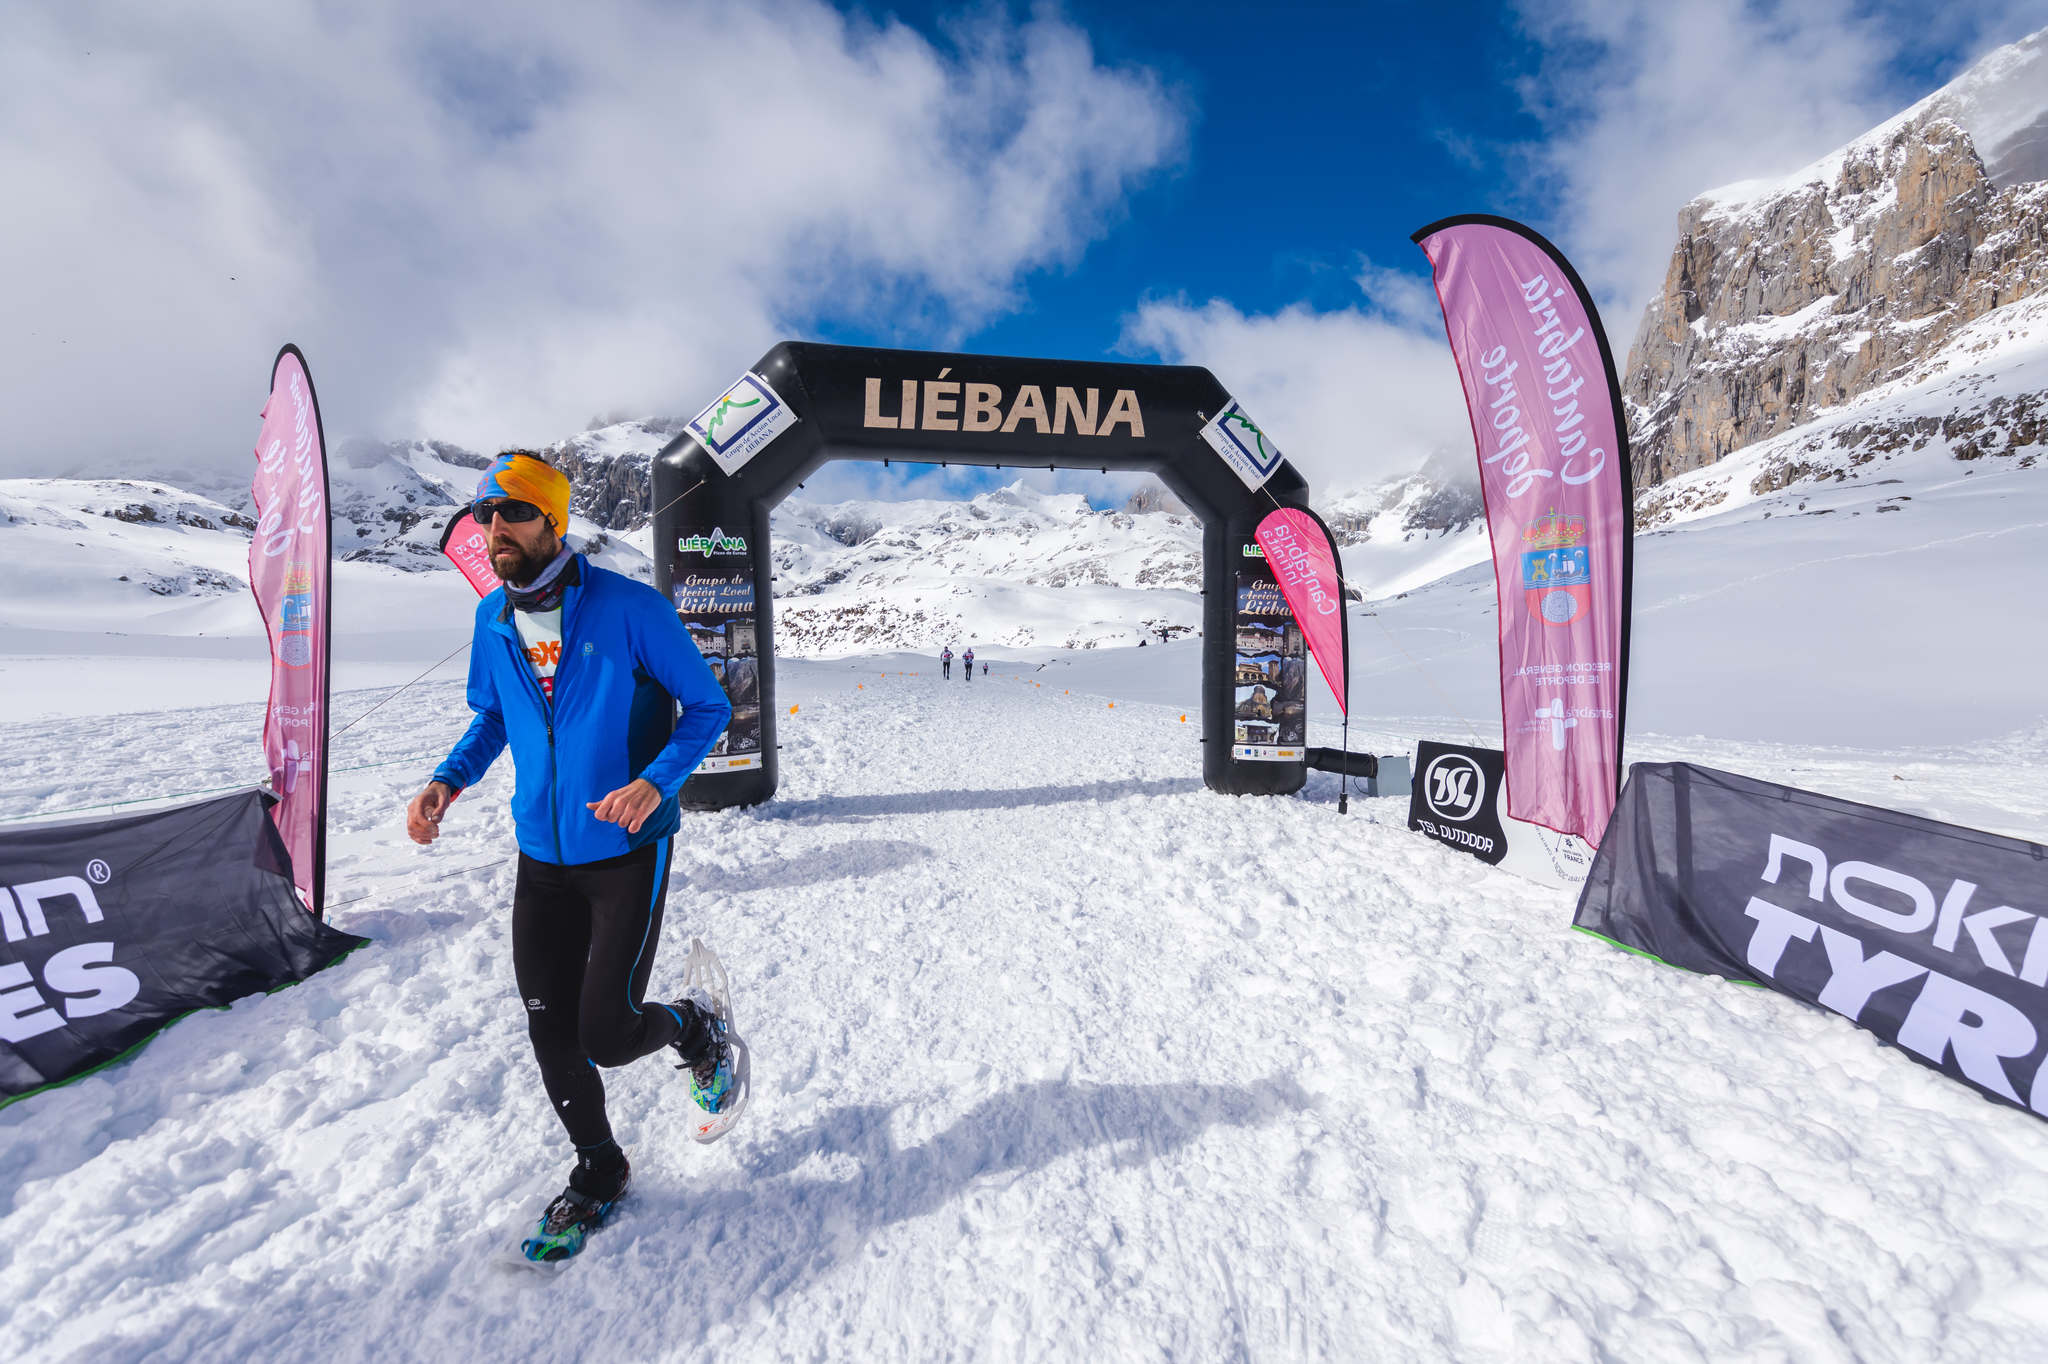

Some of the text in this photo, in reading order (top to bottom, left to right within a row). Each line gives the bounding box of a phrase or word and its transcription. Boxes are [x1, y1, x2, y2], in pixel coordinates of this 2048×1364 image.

[864, 367, 1146, 438] LIÉBANA
[679, 527, 748, 558] LIÉBANA
[685, 574, 744, 587] Grupo de
[1251, 579, 1284, 593] Grup
[675, 585, 751, 597] Acción Local
[676, 597, 754, 614] Liébana
[1239, 599, 1293, 617] Liéba
[1433, 767, 1473, 808] TSL
[1417, 819, 1494, 853] TSL OUTDOOR
